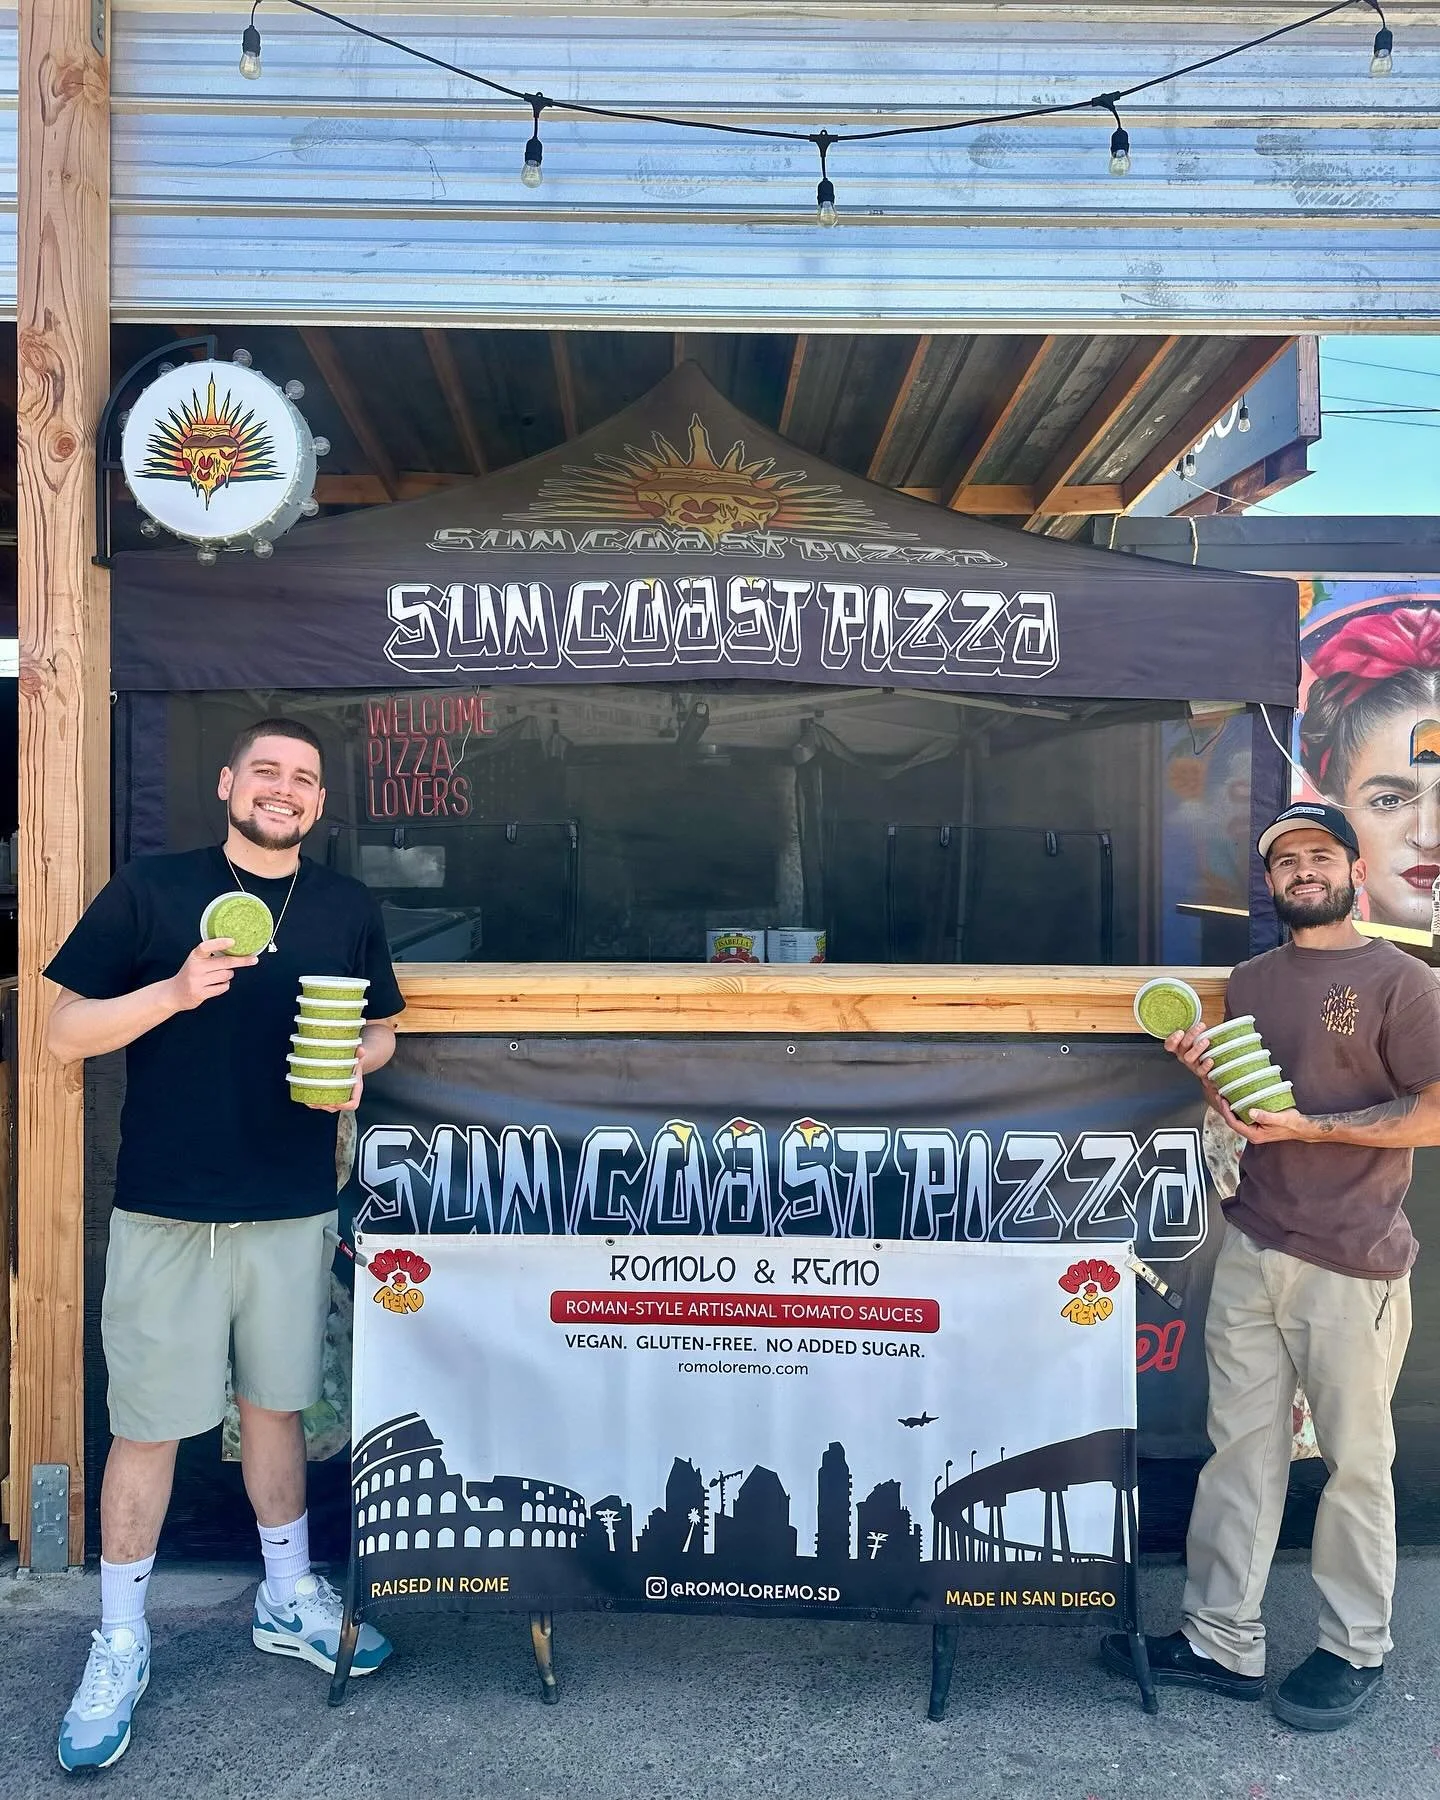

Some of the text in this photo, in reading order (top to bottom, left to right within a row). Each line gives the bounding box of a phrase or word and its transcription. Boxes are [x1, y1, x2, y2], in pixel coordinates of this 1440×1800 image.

[426, 528, 577, 553] SUN
[383, 575, 1060, 678] SUN COAST PIZZA
[367, 695, 496, 736] WELCOME
[368, 737, 453, 777] PIZZA
[369, 777, 469, 817] LOVERS
[717, 937, 750, 948] ISABELLA
[354, 1117, 1208, 1262] SUN COAST PIZZA
[609, 1254, 880, 1287] ROMOLO & REMO
[373, 1285, 425, 1315] REMO
[566, 1300, 924, 1323] ROMAN-STYLE ARTISANAL TOMATO SAUCES
[1060, 1296, 1113, 1326] REMO
[565, 1334, 925, 1358] VEGAN. GLUTEN-FREE. NO ADDED SUGAR.
[678, 1360, 809, 1375] romoloremo.com
[371, 1576, 509, 1597] RAISED IN ROME
[670, 1581, 841, 1602] @ROMOLOREMO.SD
[946, 1590, 1116, 1607] MADE IN SAN DIEGO
